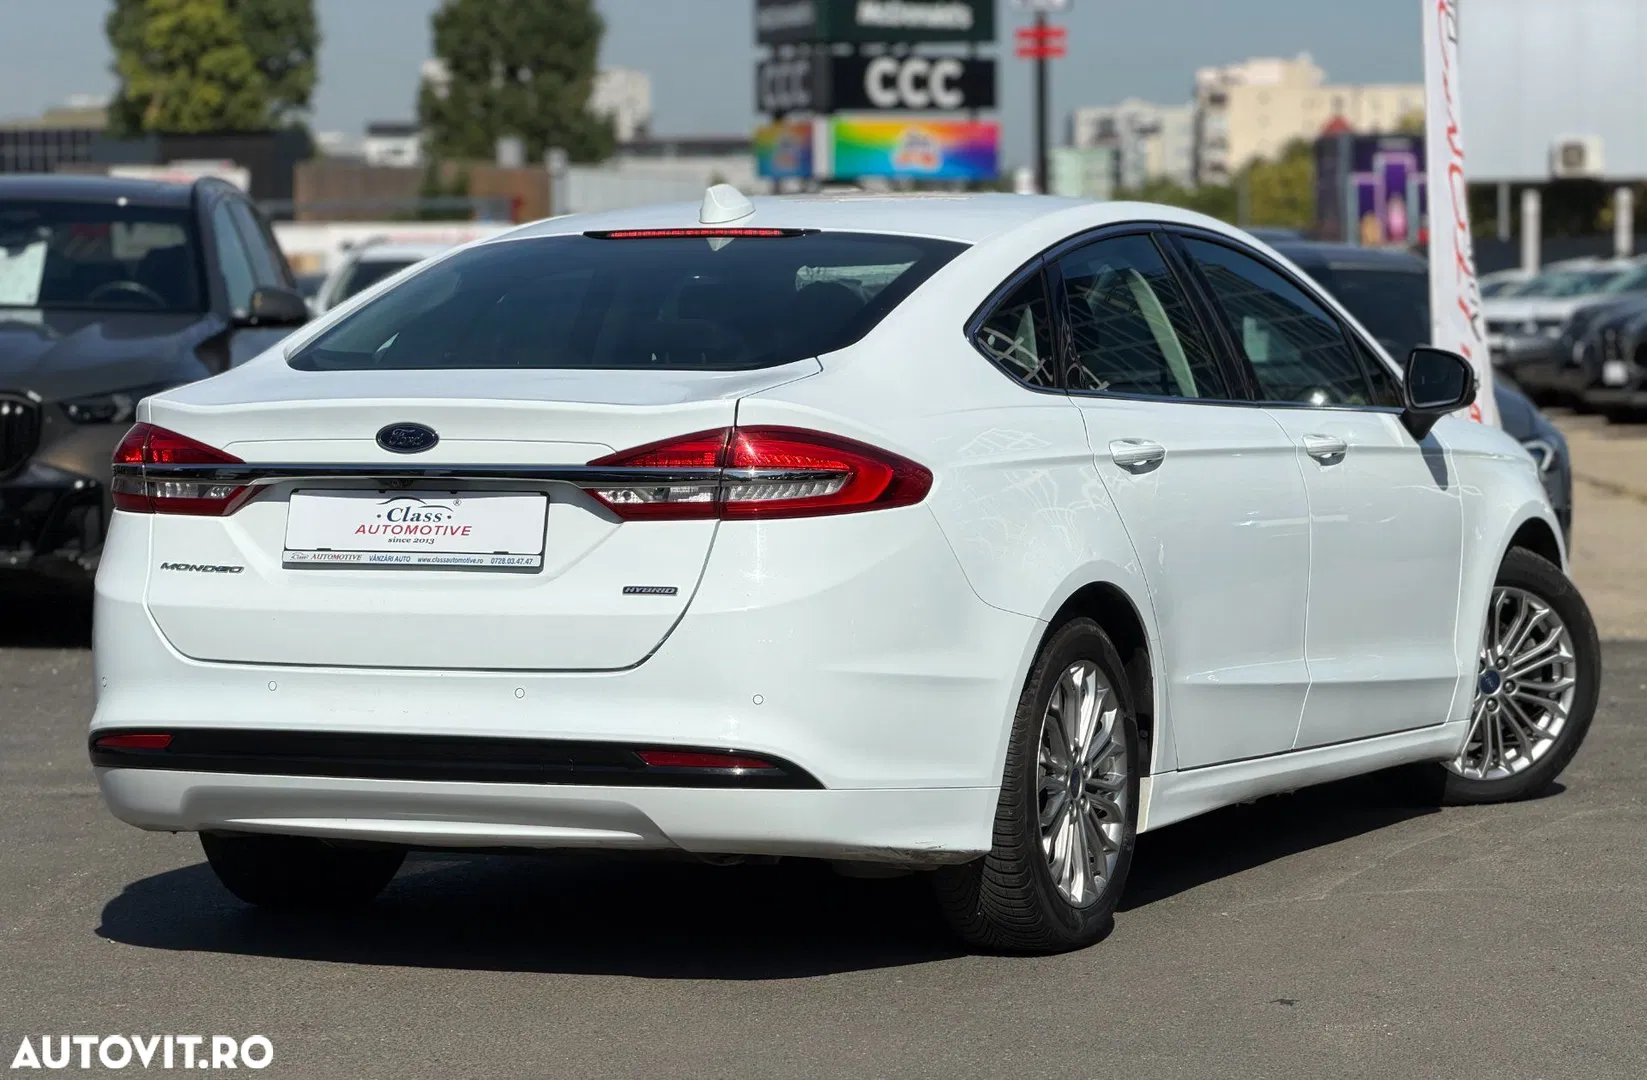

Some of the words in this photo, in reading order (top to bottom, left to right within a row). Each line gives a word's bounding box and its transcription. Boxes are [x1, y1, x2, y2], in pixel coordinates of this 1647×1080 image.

[864, 56, 963, 107] CCC
[386, 506, 442, 522] Class
[355, 524, 472, 536] AUTOMOTIVE
[388, 536, 411, 544] since
[413, 537, 435, 545] 2013
[311, 553, 362, 561] AUTOMOTIVE
[395, 555, 411, 563] AUTO
[417, 556, 484, 564] www.classautomotive.ro
[490, 557, 534, 565] 0728.03.47.47
[160, 562, 244, 573] MONDEO
